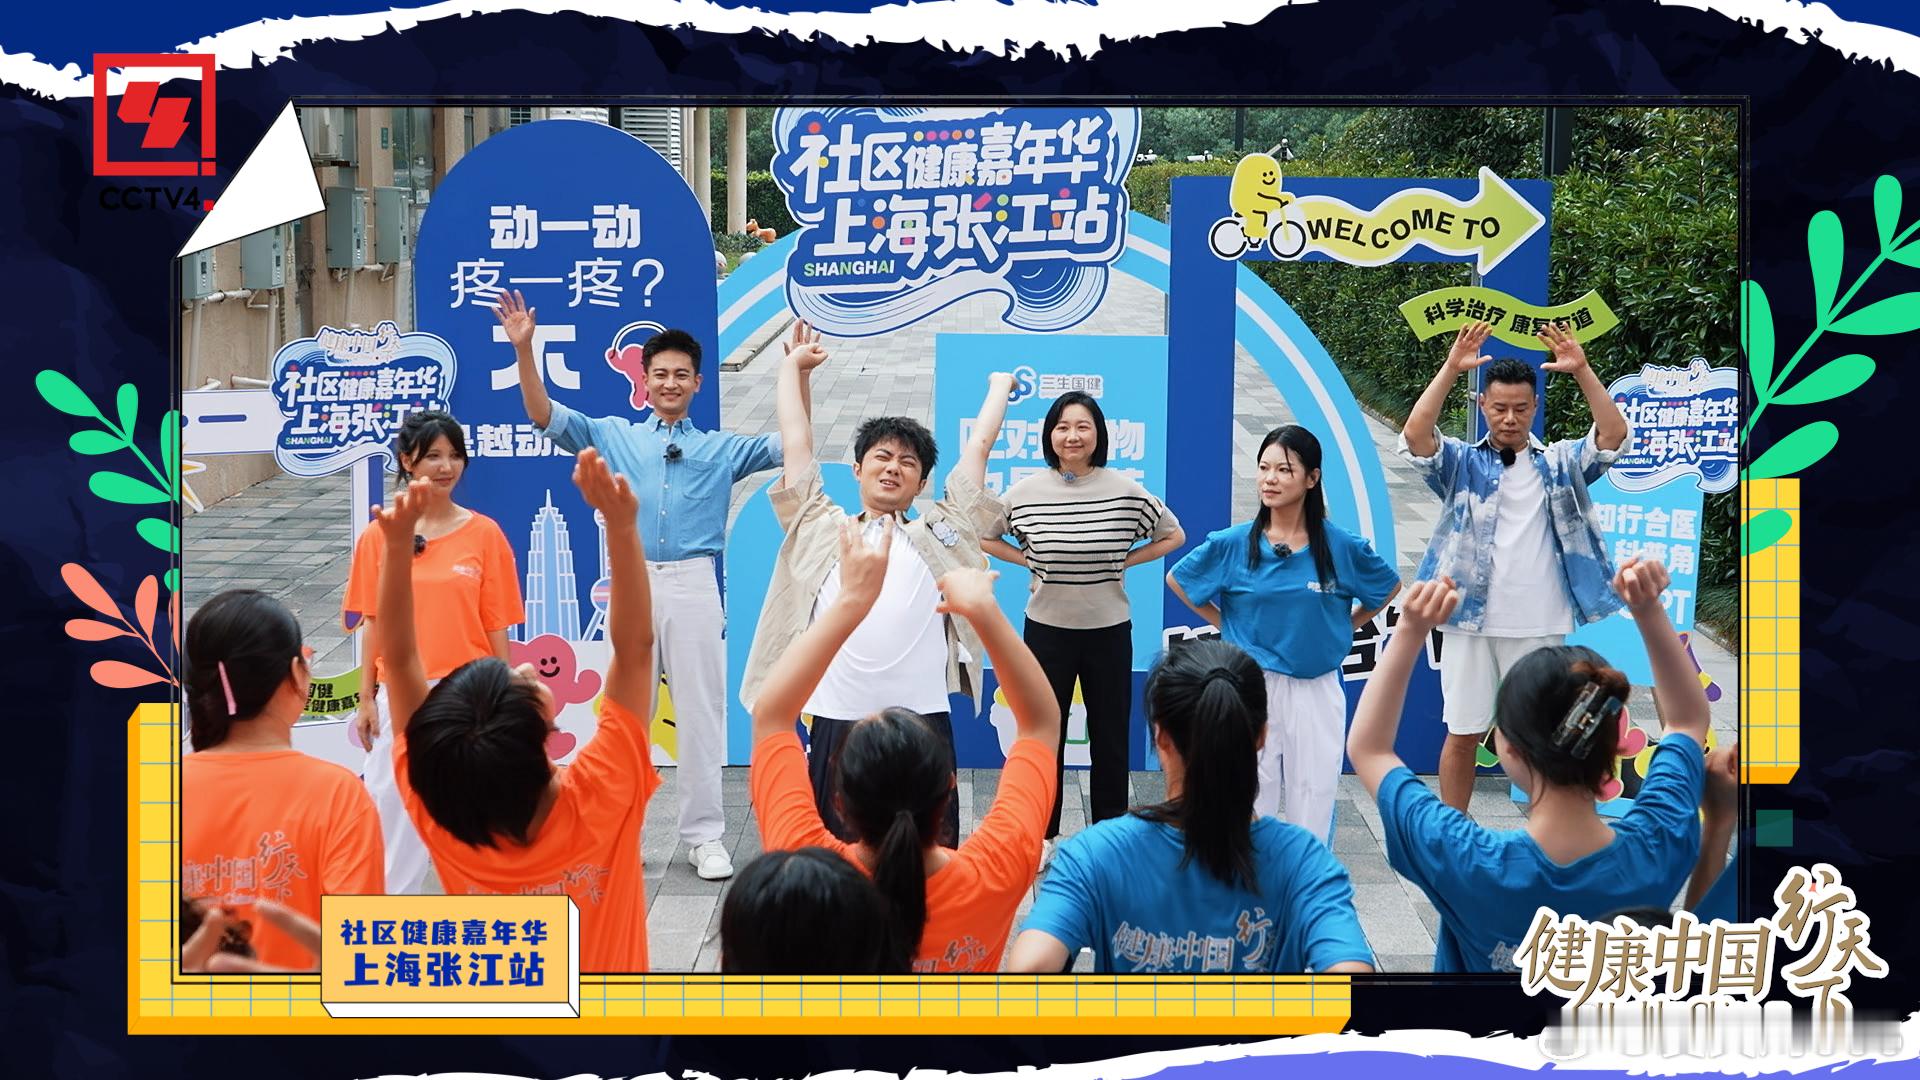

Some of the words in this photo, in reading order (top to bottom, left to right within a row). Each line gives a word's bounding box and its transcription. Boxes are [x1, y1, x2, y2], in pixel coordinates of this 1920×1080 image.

[789, 115, 1104, 204] 社区健康嘉年华
[489, 204, 642, 249] 动一动
[813, 185, 1110, 270] 上海张江站
[1306, 208, 1455, 249] WELCOME
[1463, 216, 1501, 240] TO
[803, 260, 896, 277] SHANGHAI
[1423, 298, 1508, 326] 科学治疗
[279, 363, 439, 408] 社区健康嘉年华
[1040, 376, 1102, 390] 三生国健
[284, 436, 333, 446] SHANGHAI
